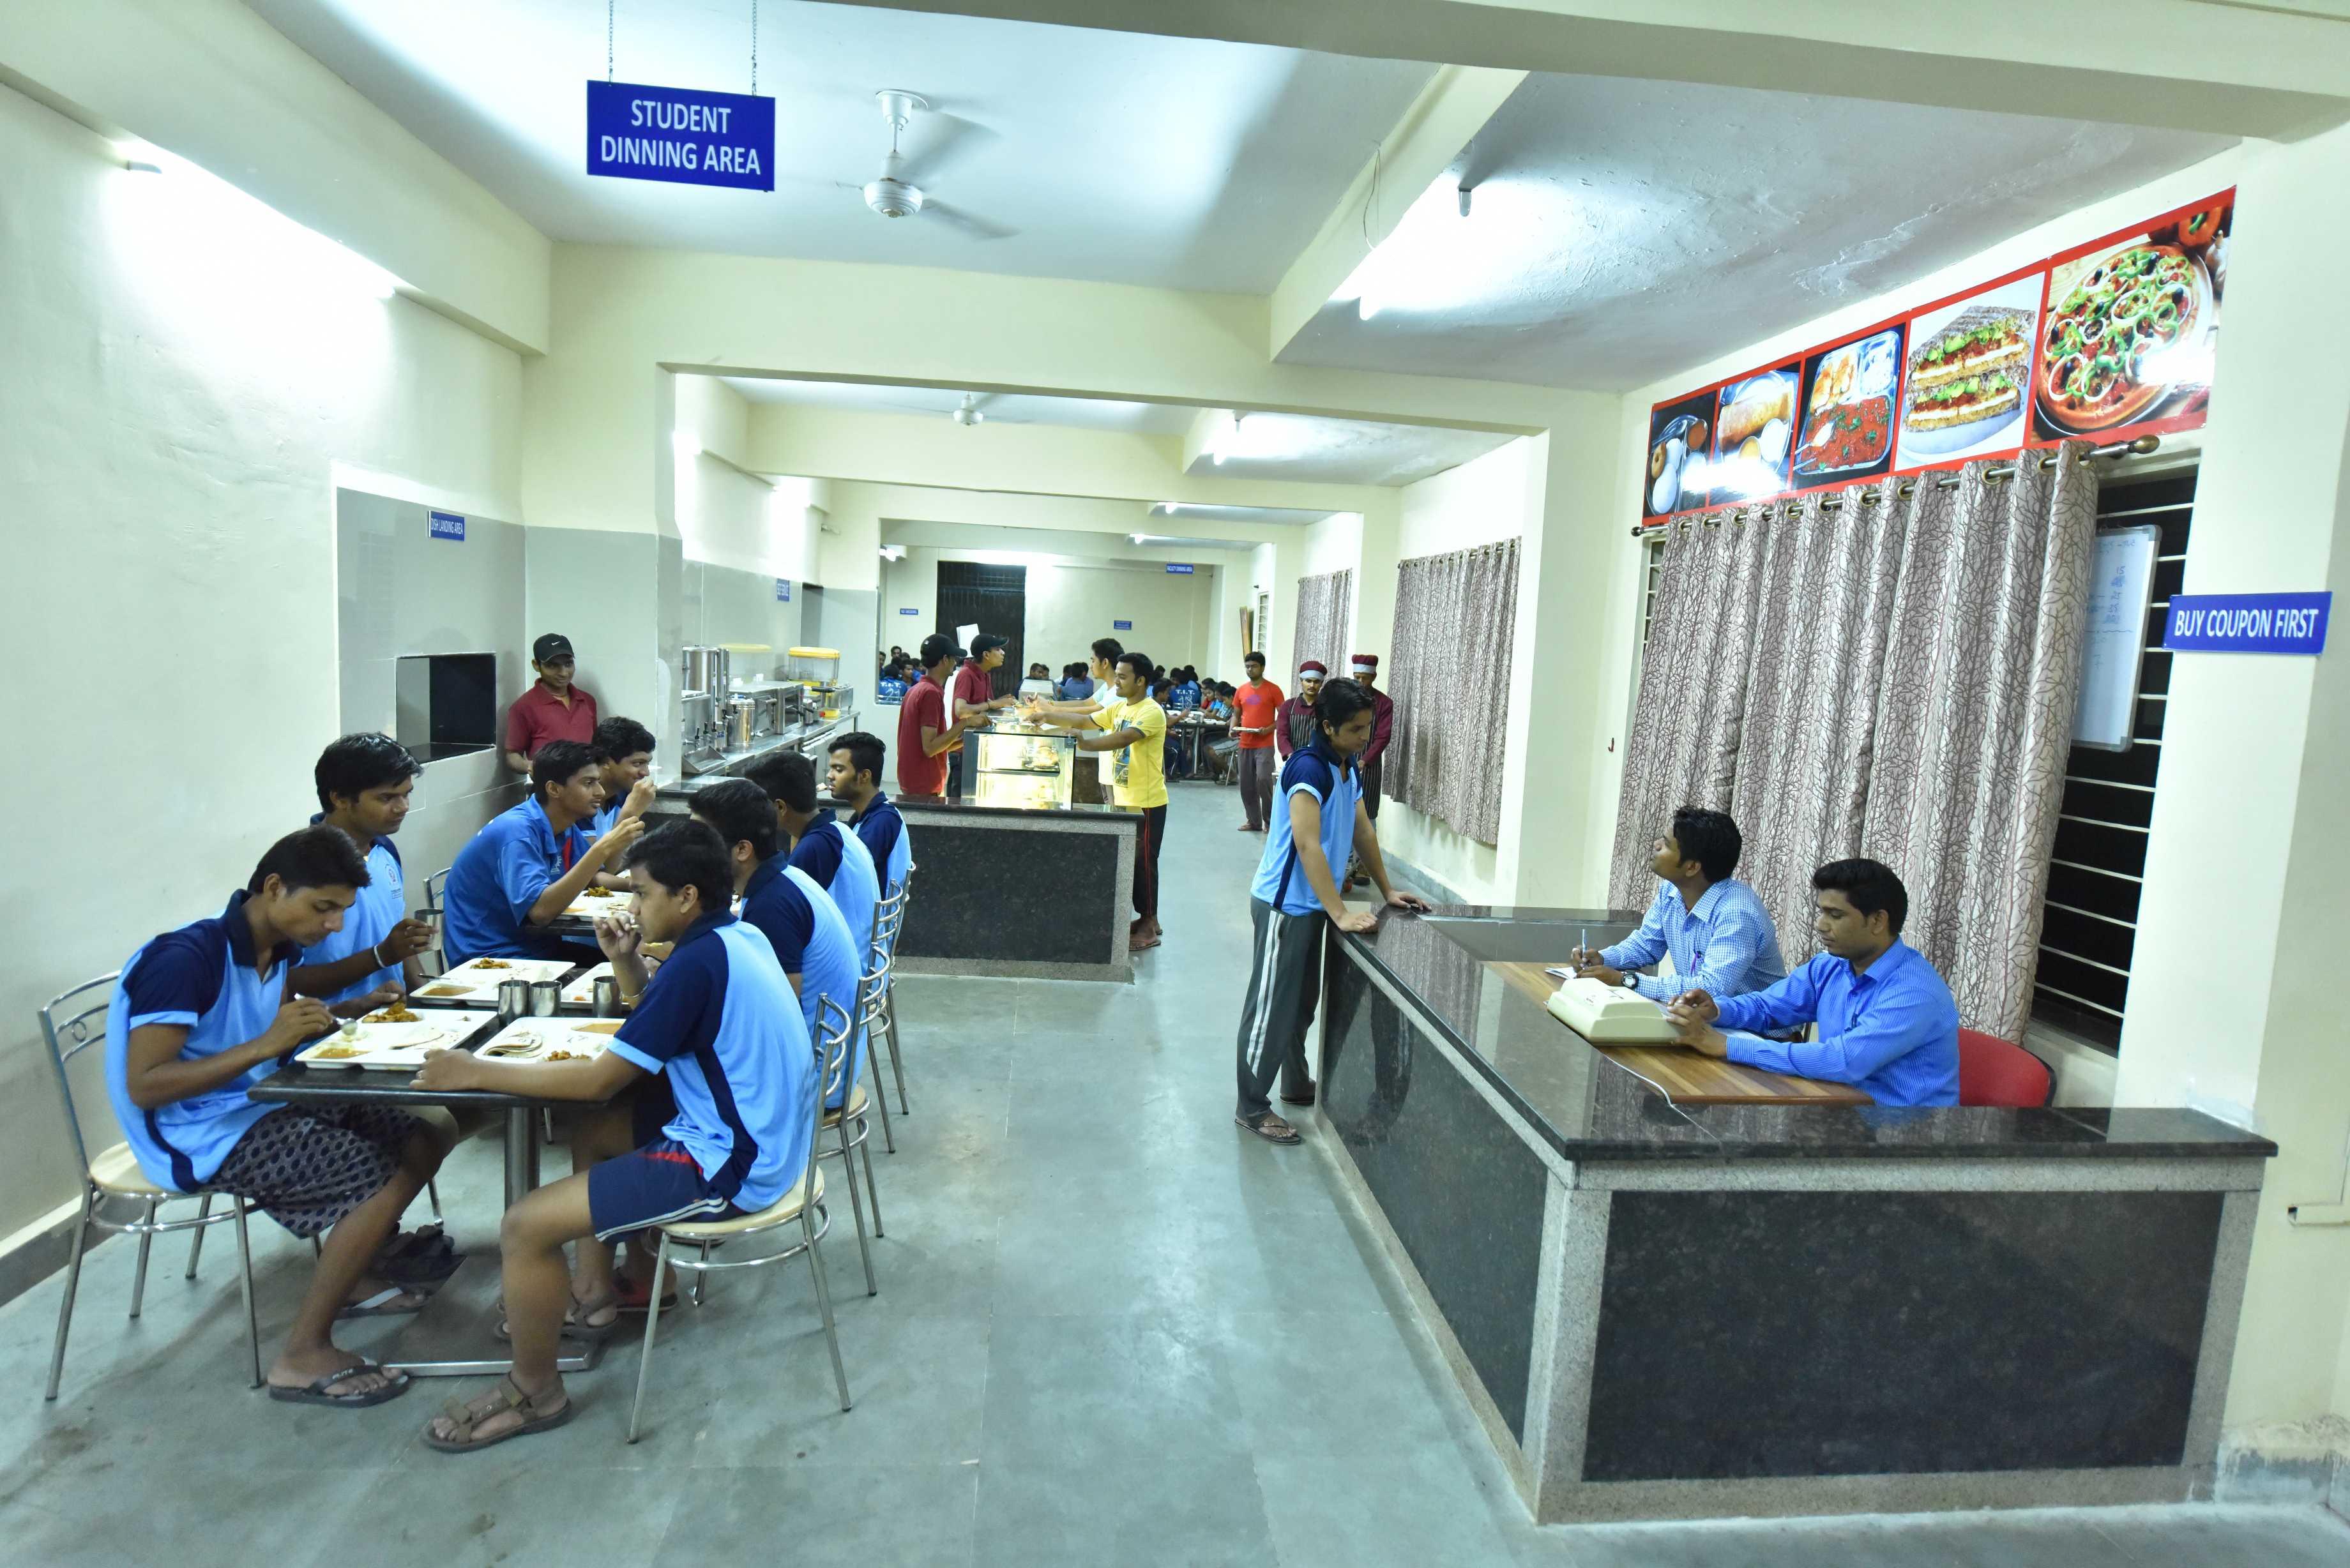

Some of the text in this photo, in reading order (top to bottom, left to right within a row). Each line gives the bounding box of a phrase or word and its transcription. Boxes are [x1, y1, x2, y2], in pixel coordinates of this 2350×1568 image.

[631, 99, 731, 134] STUDENT
[601, 135, 761, 176] DINNING AREA
[454, 522, 464, 535] AREA
[2174, 608, 2319, 638] BUY COUPON FIRST
